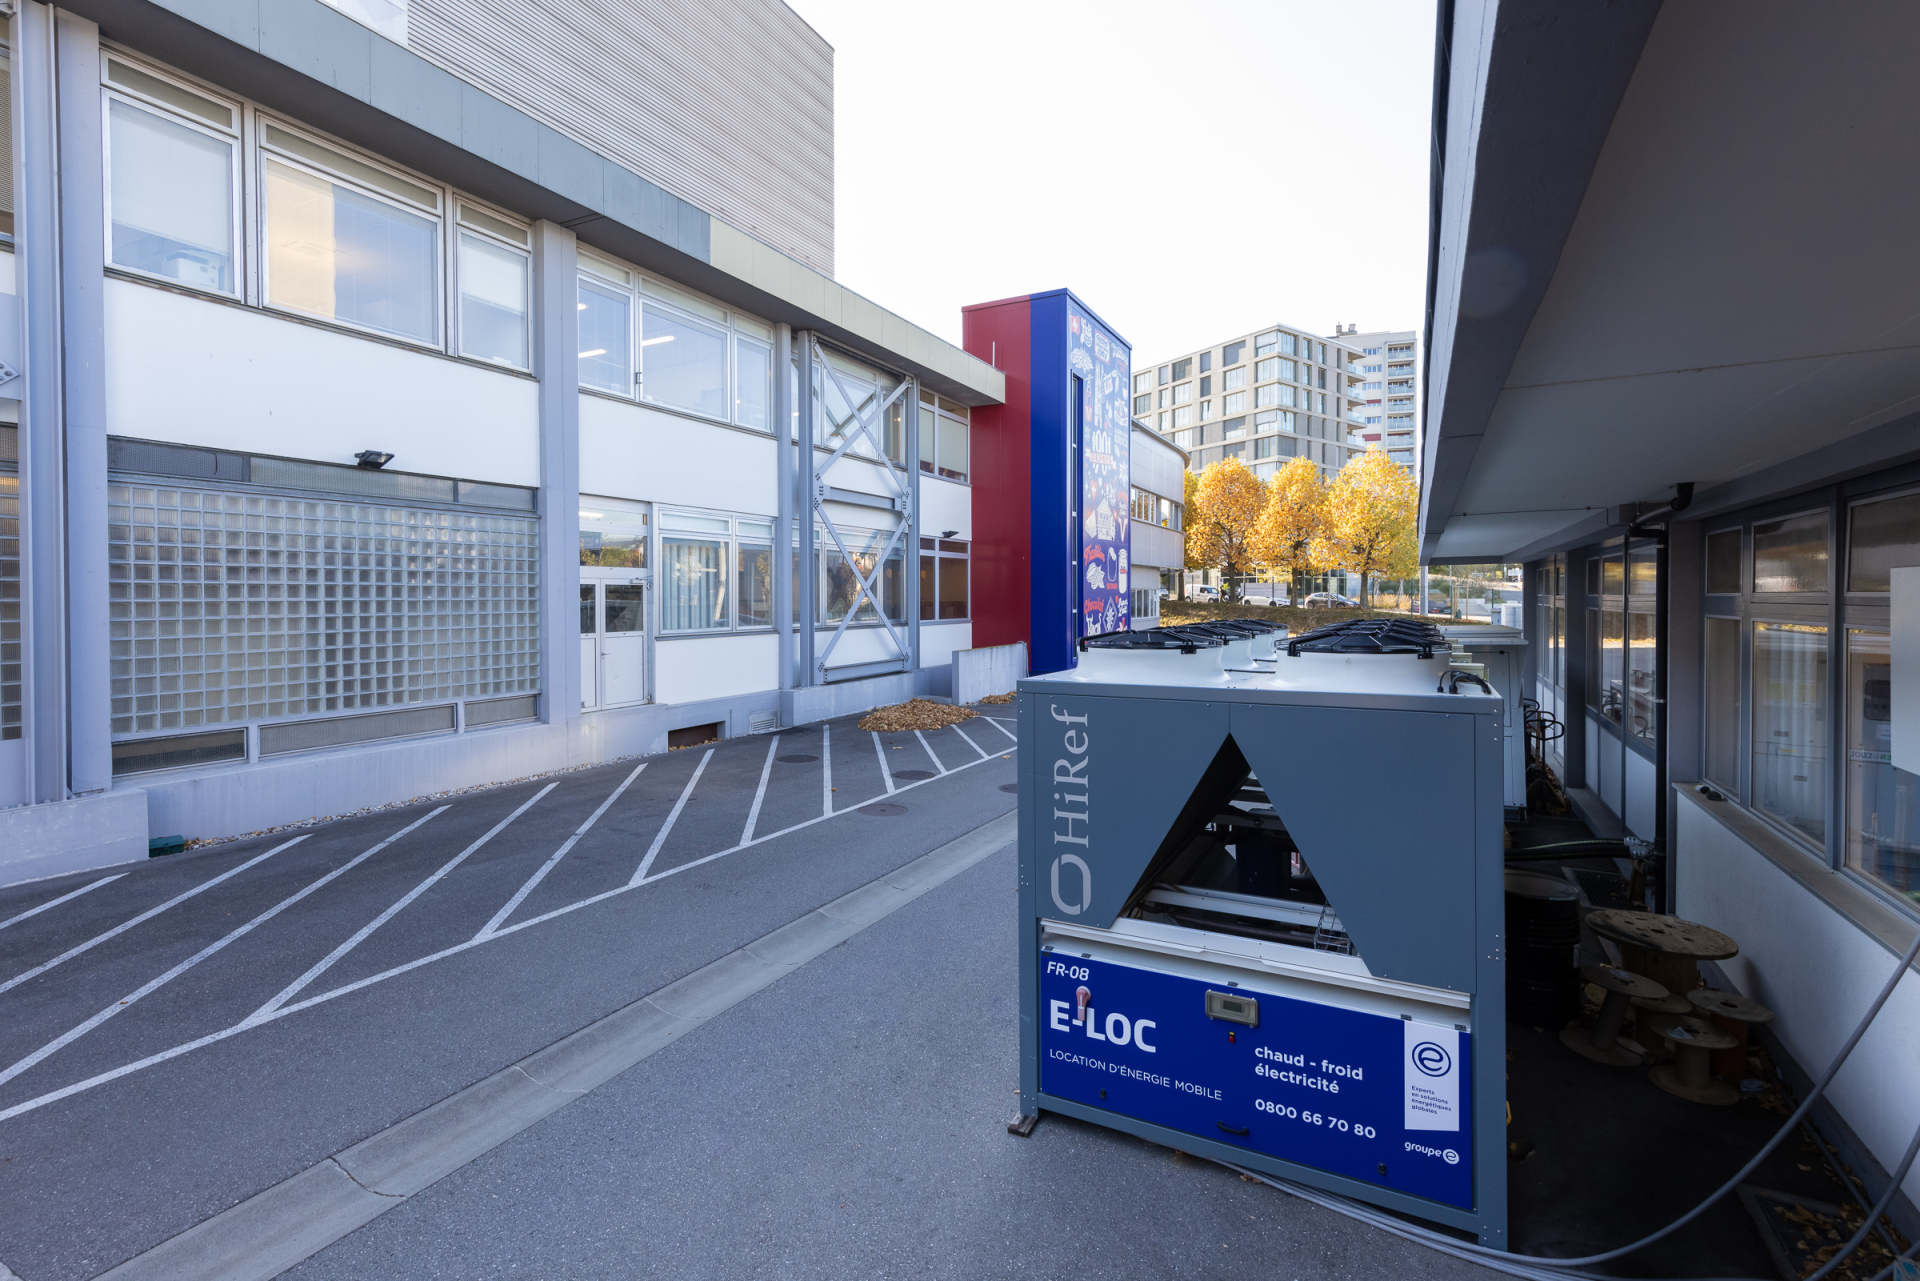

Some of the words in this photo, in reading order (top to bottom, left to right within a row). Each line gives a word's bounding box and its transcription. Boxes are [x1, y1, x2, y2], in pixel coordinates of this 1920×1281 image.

[1091, 453, 1112, 464] DEPUIS
[1051, 704, 1089, 849] HiRef
[1047, 961, 1089, 981] FR-08
[1050, 999, 1156, 1053] E-LOC
[1050, 1049, 1105, 1071] LOCATION
[1109, 1063, 1170, 1088] D'ÉNERGIE
[1175, 1080, 1222, 1101] MOBILE
[1255, 1046, 1304, 1067] chaud
[1321, 1059, 1363, 1081] froid
[1255, 1063, 1339, 1094] électricité
[1411, 1085, 1435, 1095] Experts
[1411, 1104, 1438, 1115] globales
[1420, 1093, 1449, 1105] solutions
[1255, 1099, 1297, 1119] 0800
[1302, 1110, 1323, 1126] 66
[1327, 1116, 1349, 1132] 70
[1353, 1123, 1376, 1139] 80
[1404, 1141, 1442, 1158] groupe
